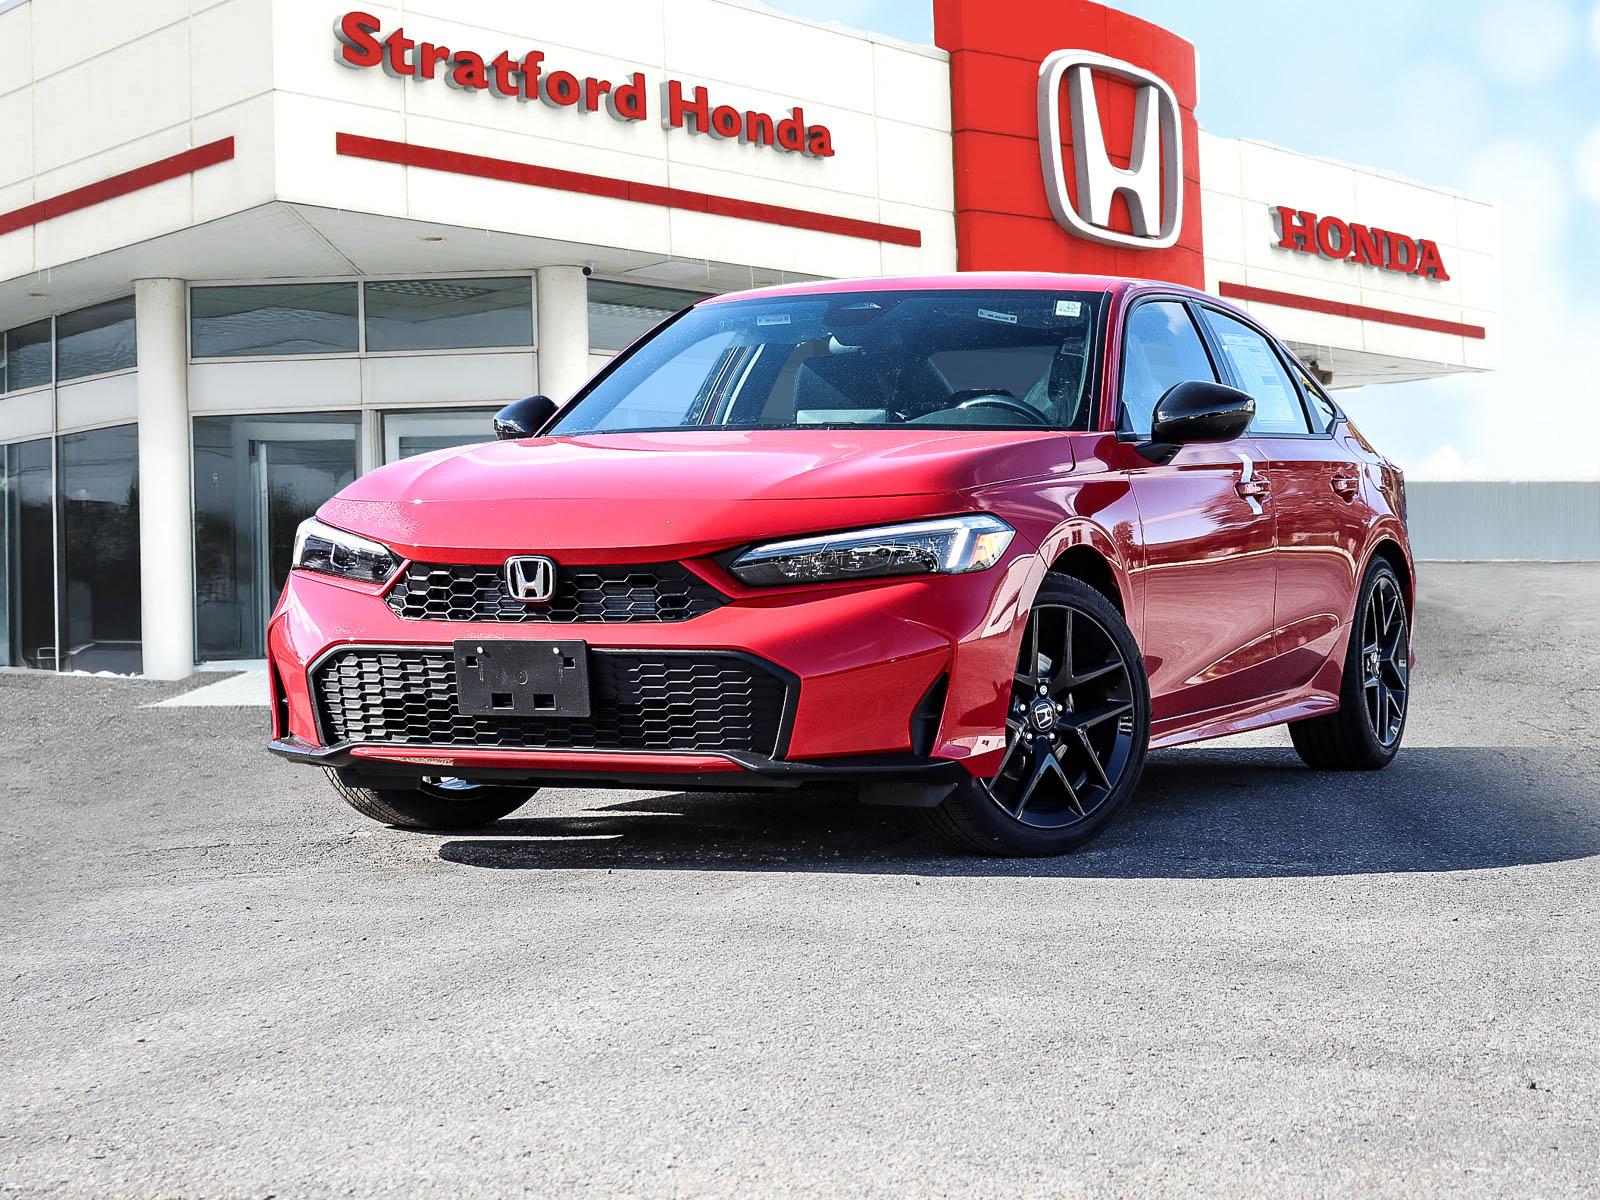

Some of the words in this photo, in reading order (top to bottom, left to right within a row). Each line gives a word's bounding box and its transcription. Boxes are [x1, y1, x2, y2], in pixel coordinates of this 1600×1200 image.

[336, 11, 647, 122] Stratford
[663, 79, 835, 158] Honda
[1271, 205, 1450, 282] HONDA
